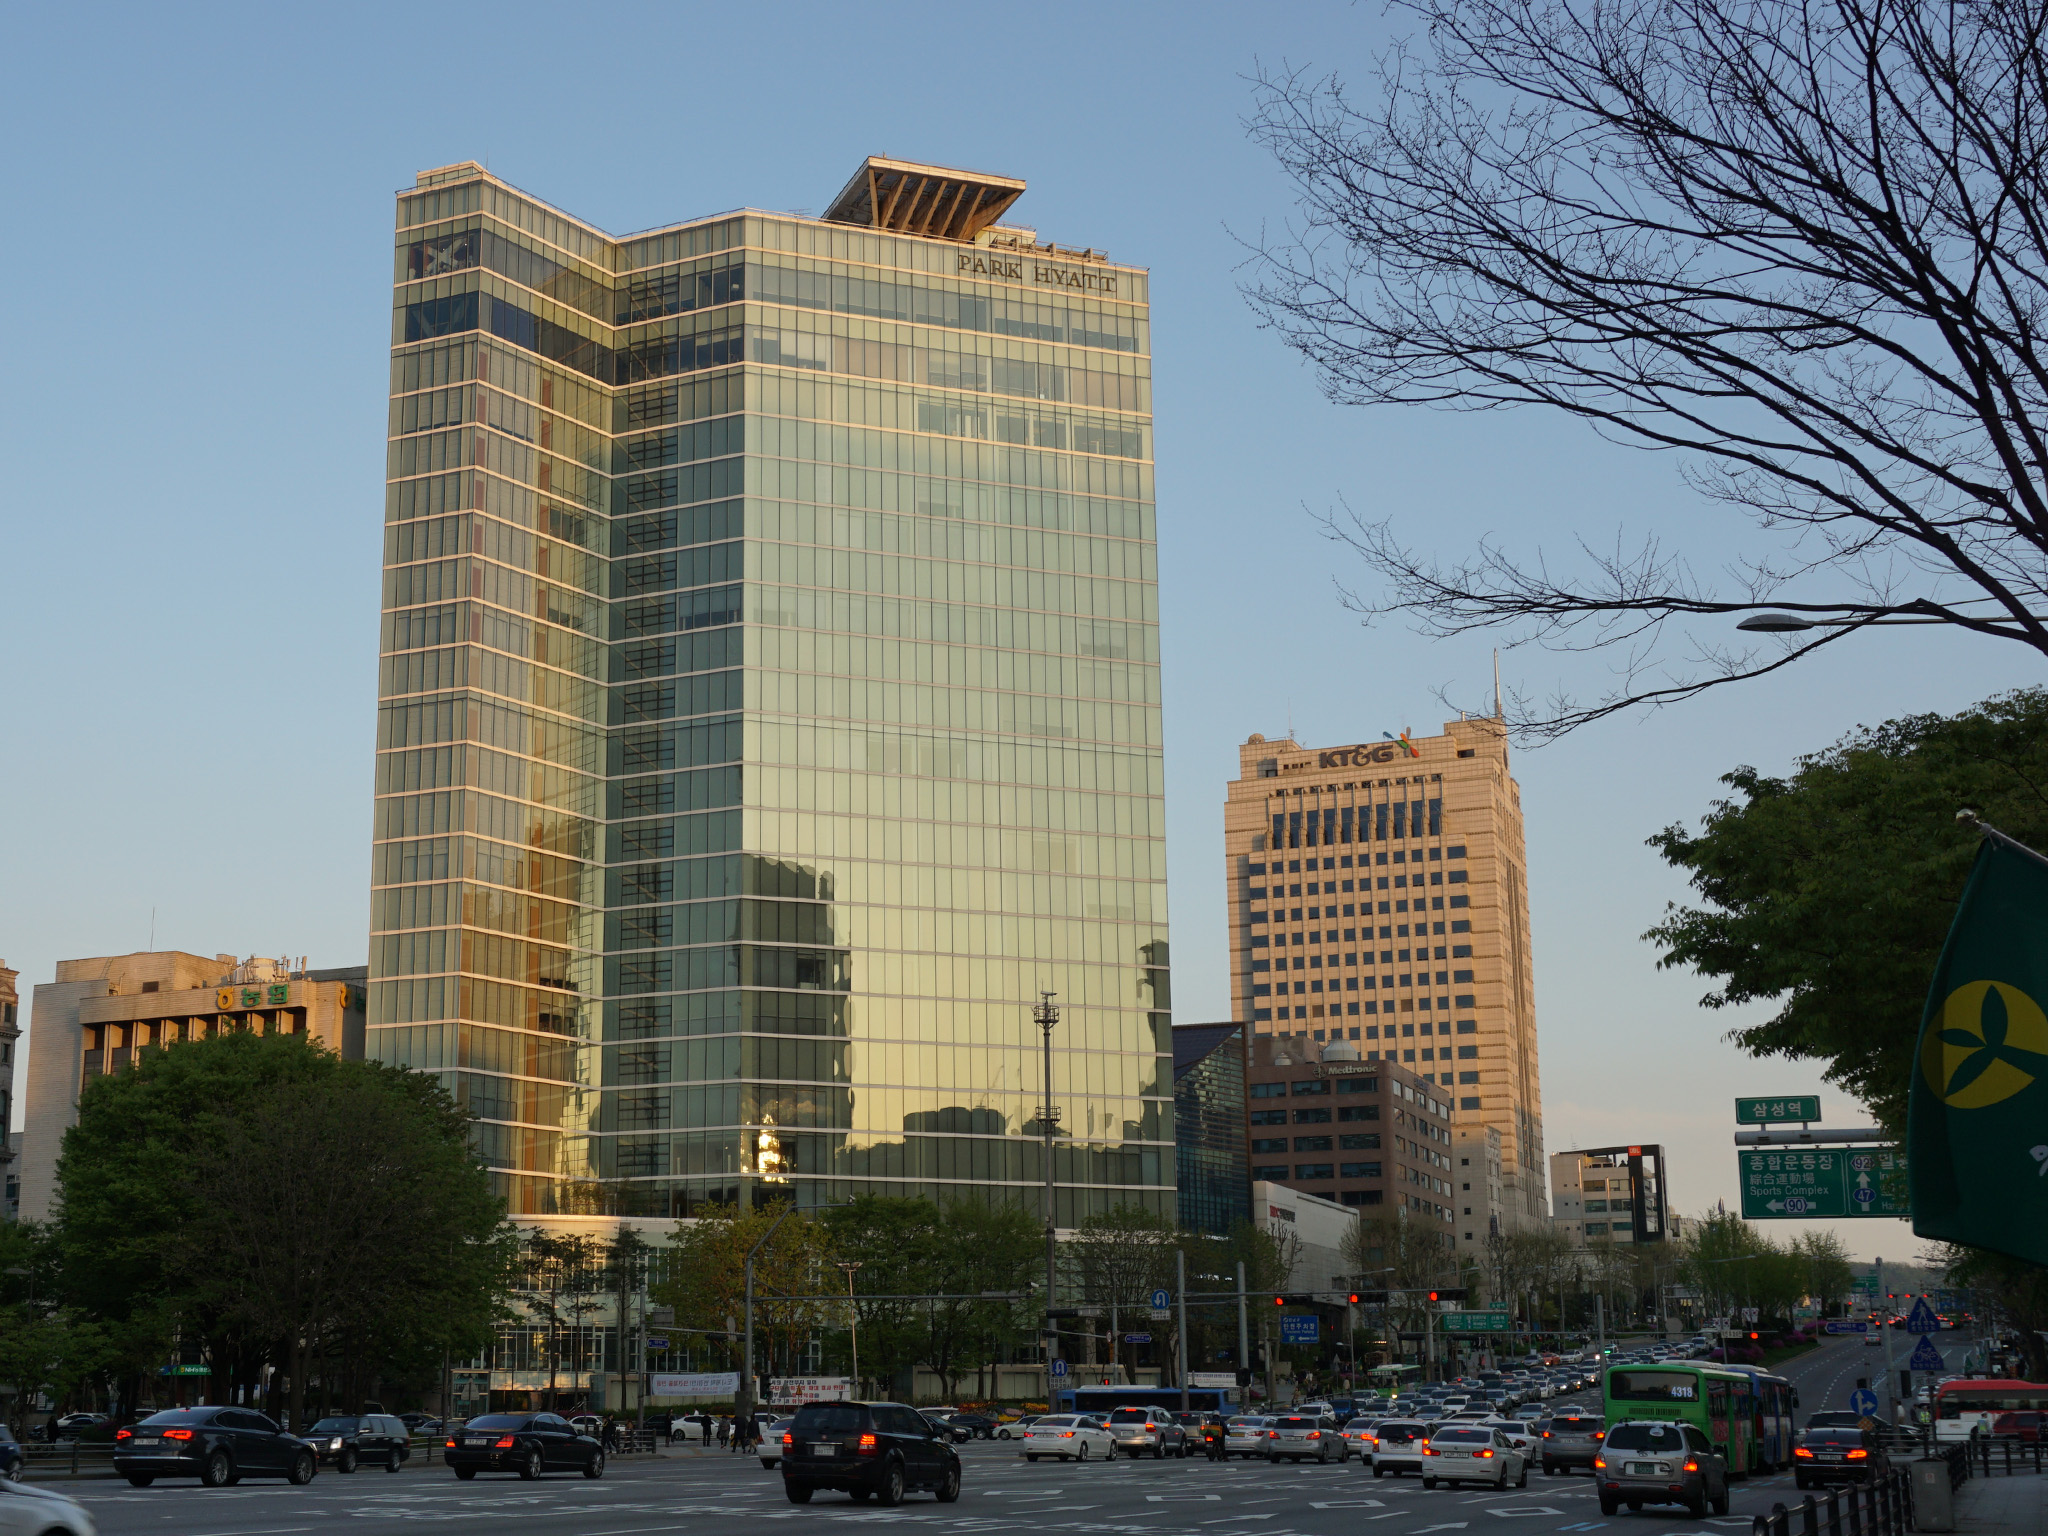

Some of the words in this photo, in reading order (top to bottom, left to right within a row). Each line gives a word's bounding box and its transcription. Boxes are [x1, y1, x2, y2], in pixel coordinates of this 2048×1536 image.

[958, 255, 1023, 280] PARK
[1034, 265, 1115, 292] HYATT
[1319, 744, 1394, 768] KT&G
[243, 984, 288, 1007] 농협
[1328, 1065, 1378, 1076] Medtronic
[1753, 1101, 1802, 1117] 삼성역
[1750, 1154, 1834, 1171] 종합운동장
[1855, 1157, 1871, 1168] 92
[1750, 1173, 1815, 1186] 綜合運動場
[1750, 1186, 1782, 1197] Sports
[1784, 1185, 1829, 1197] Complex
[1857, 1189, 1871, 1201] 47
[1788, 1199, 1804, 1212] 90
[1671, 1386, 1693, 1398] 4318
